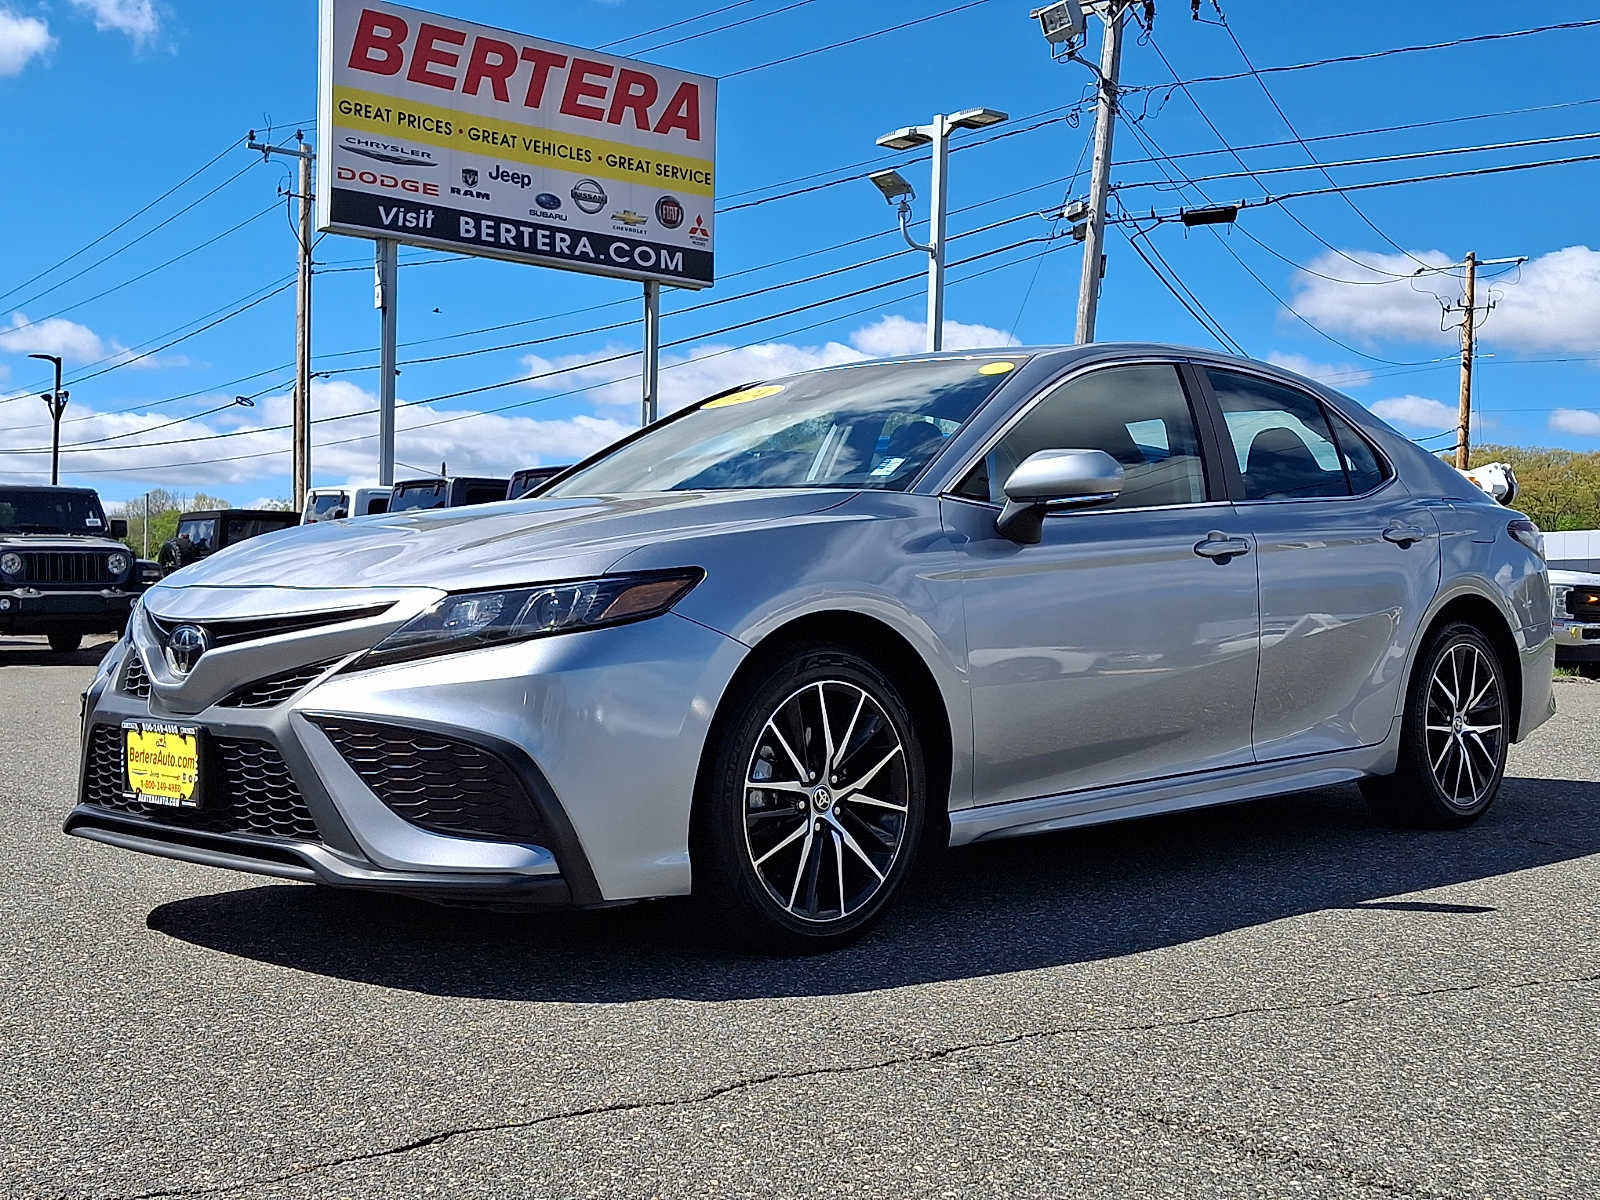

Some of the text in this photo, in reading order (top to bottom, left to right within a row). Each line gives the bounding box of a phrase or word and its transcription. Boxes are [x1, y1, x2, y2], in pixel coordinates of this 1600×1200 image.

[347, 8, 702, 141] BERTERA
[338, 100, 712, 185] GREAT PRICES GREAT VEHICLES GREAT SERVICE
[345, 136, 432, 160] CHRYSLER
[337, 166, 440, 197] DODGE
[488, 165, 532, 189] Jeep
[450, 186, 491, 201] RAM
[574, 190, 604, 202] NISSAN
[529, 208, 568, 222] SUBARU
[662, 204, 679, 221] FIAT
[378, 205, 684, 272] Visit BERTERA.COM
[612, 225, 648, 236] CHEVROLET
[129, 747, 195, 769] BerteraAuto.com
